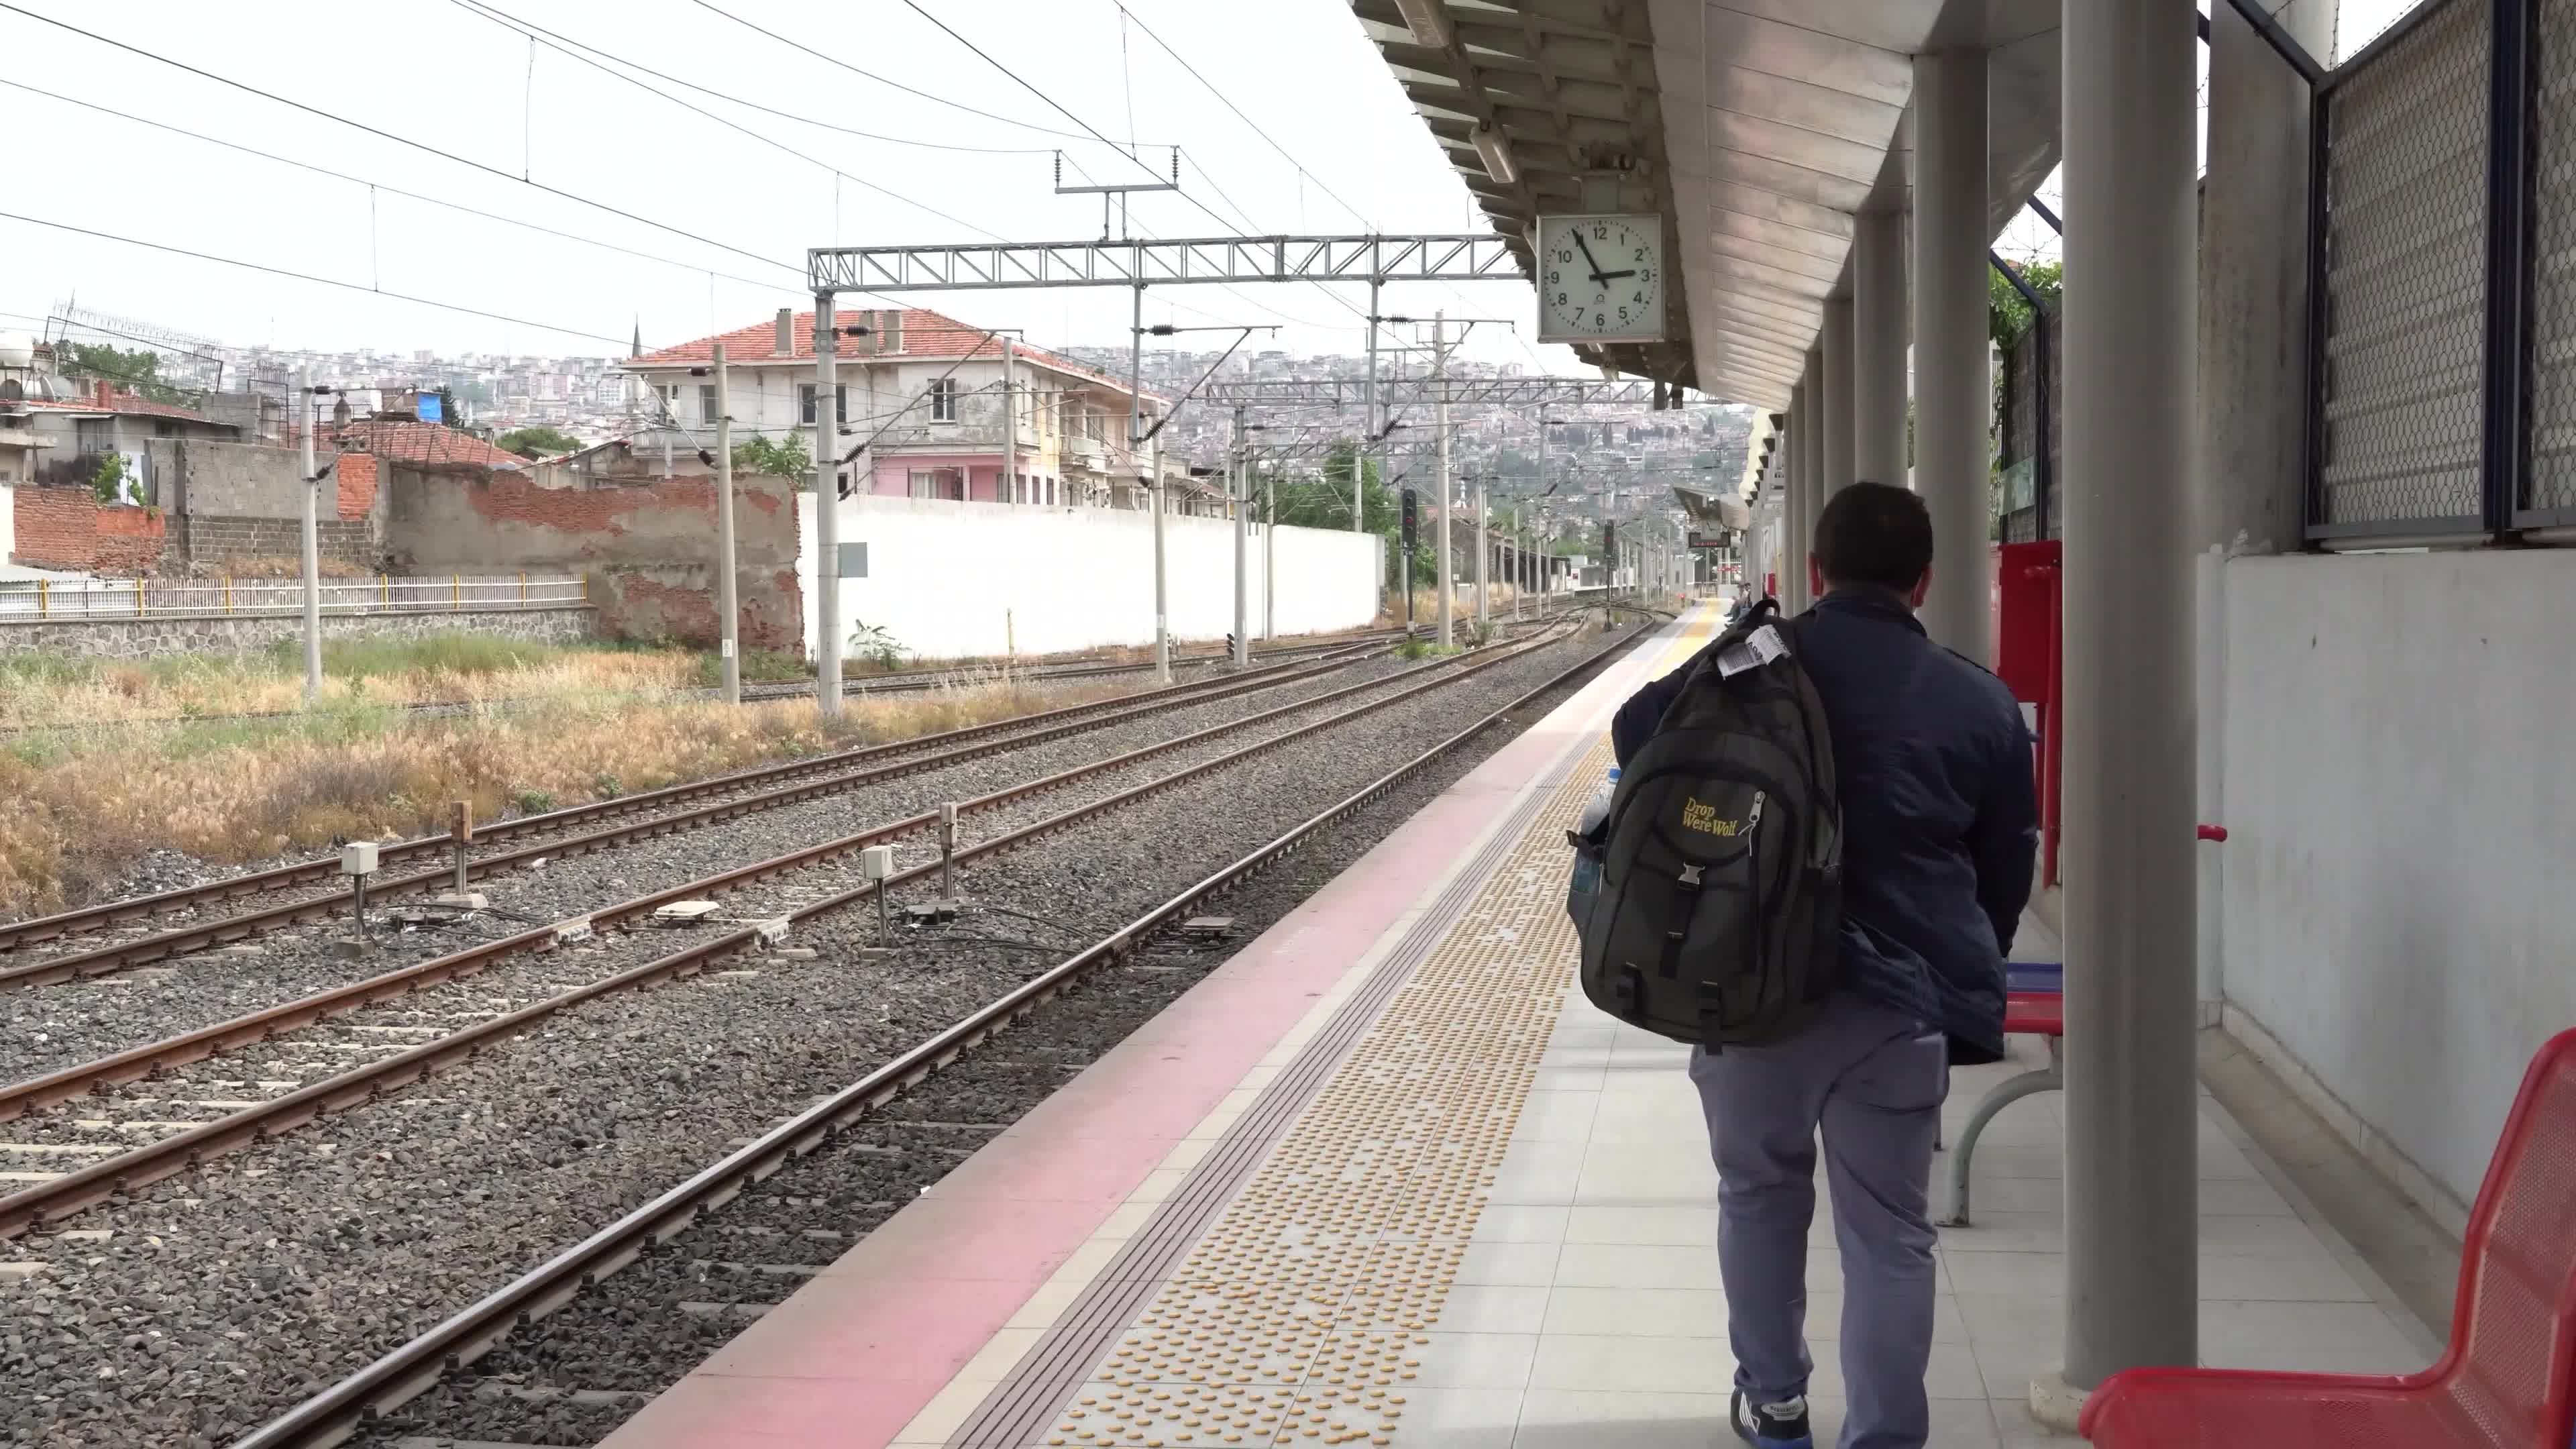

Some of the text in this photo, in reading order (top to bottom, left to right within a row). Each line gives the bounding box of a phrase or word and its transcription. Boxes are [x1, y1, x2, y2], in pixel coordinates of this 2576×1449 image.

[1593, 226, 1608, 240] 12
[1619, 233, 1625, 246] 1
[1558, 250, 1572, 263] 10
[1635, 248, 1644, 262] 2
[1550, 271, 1560, 284] 9
[1641, 269, 1650, 282] 3
[1558, 292, 1568, 305] 8
[1633, 290, 1642, 304] 4
[1576, 307, 1585, 320] 7
[1618, 306, 1627, 319] 5
[1595, 313, 1605, 326] 6
[1684, 796, 1715, 821] Drop
